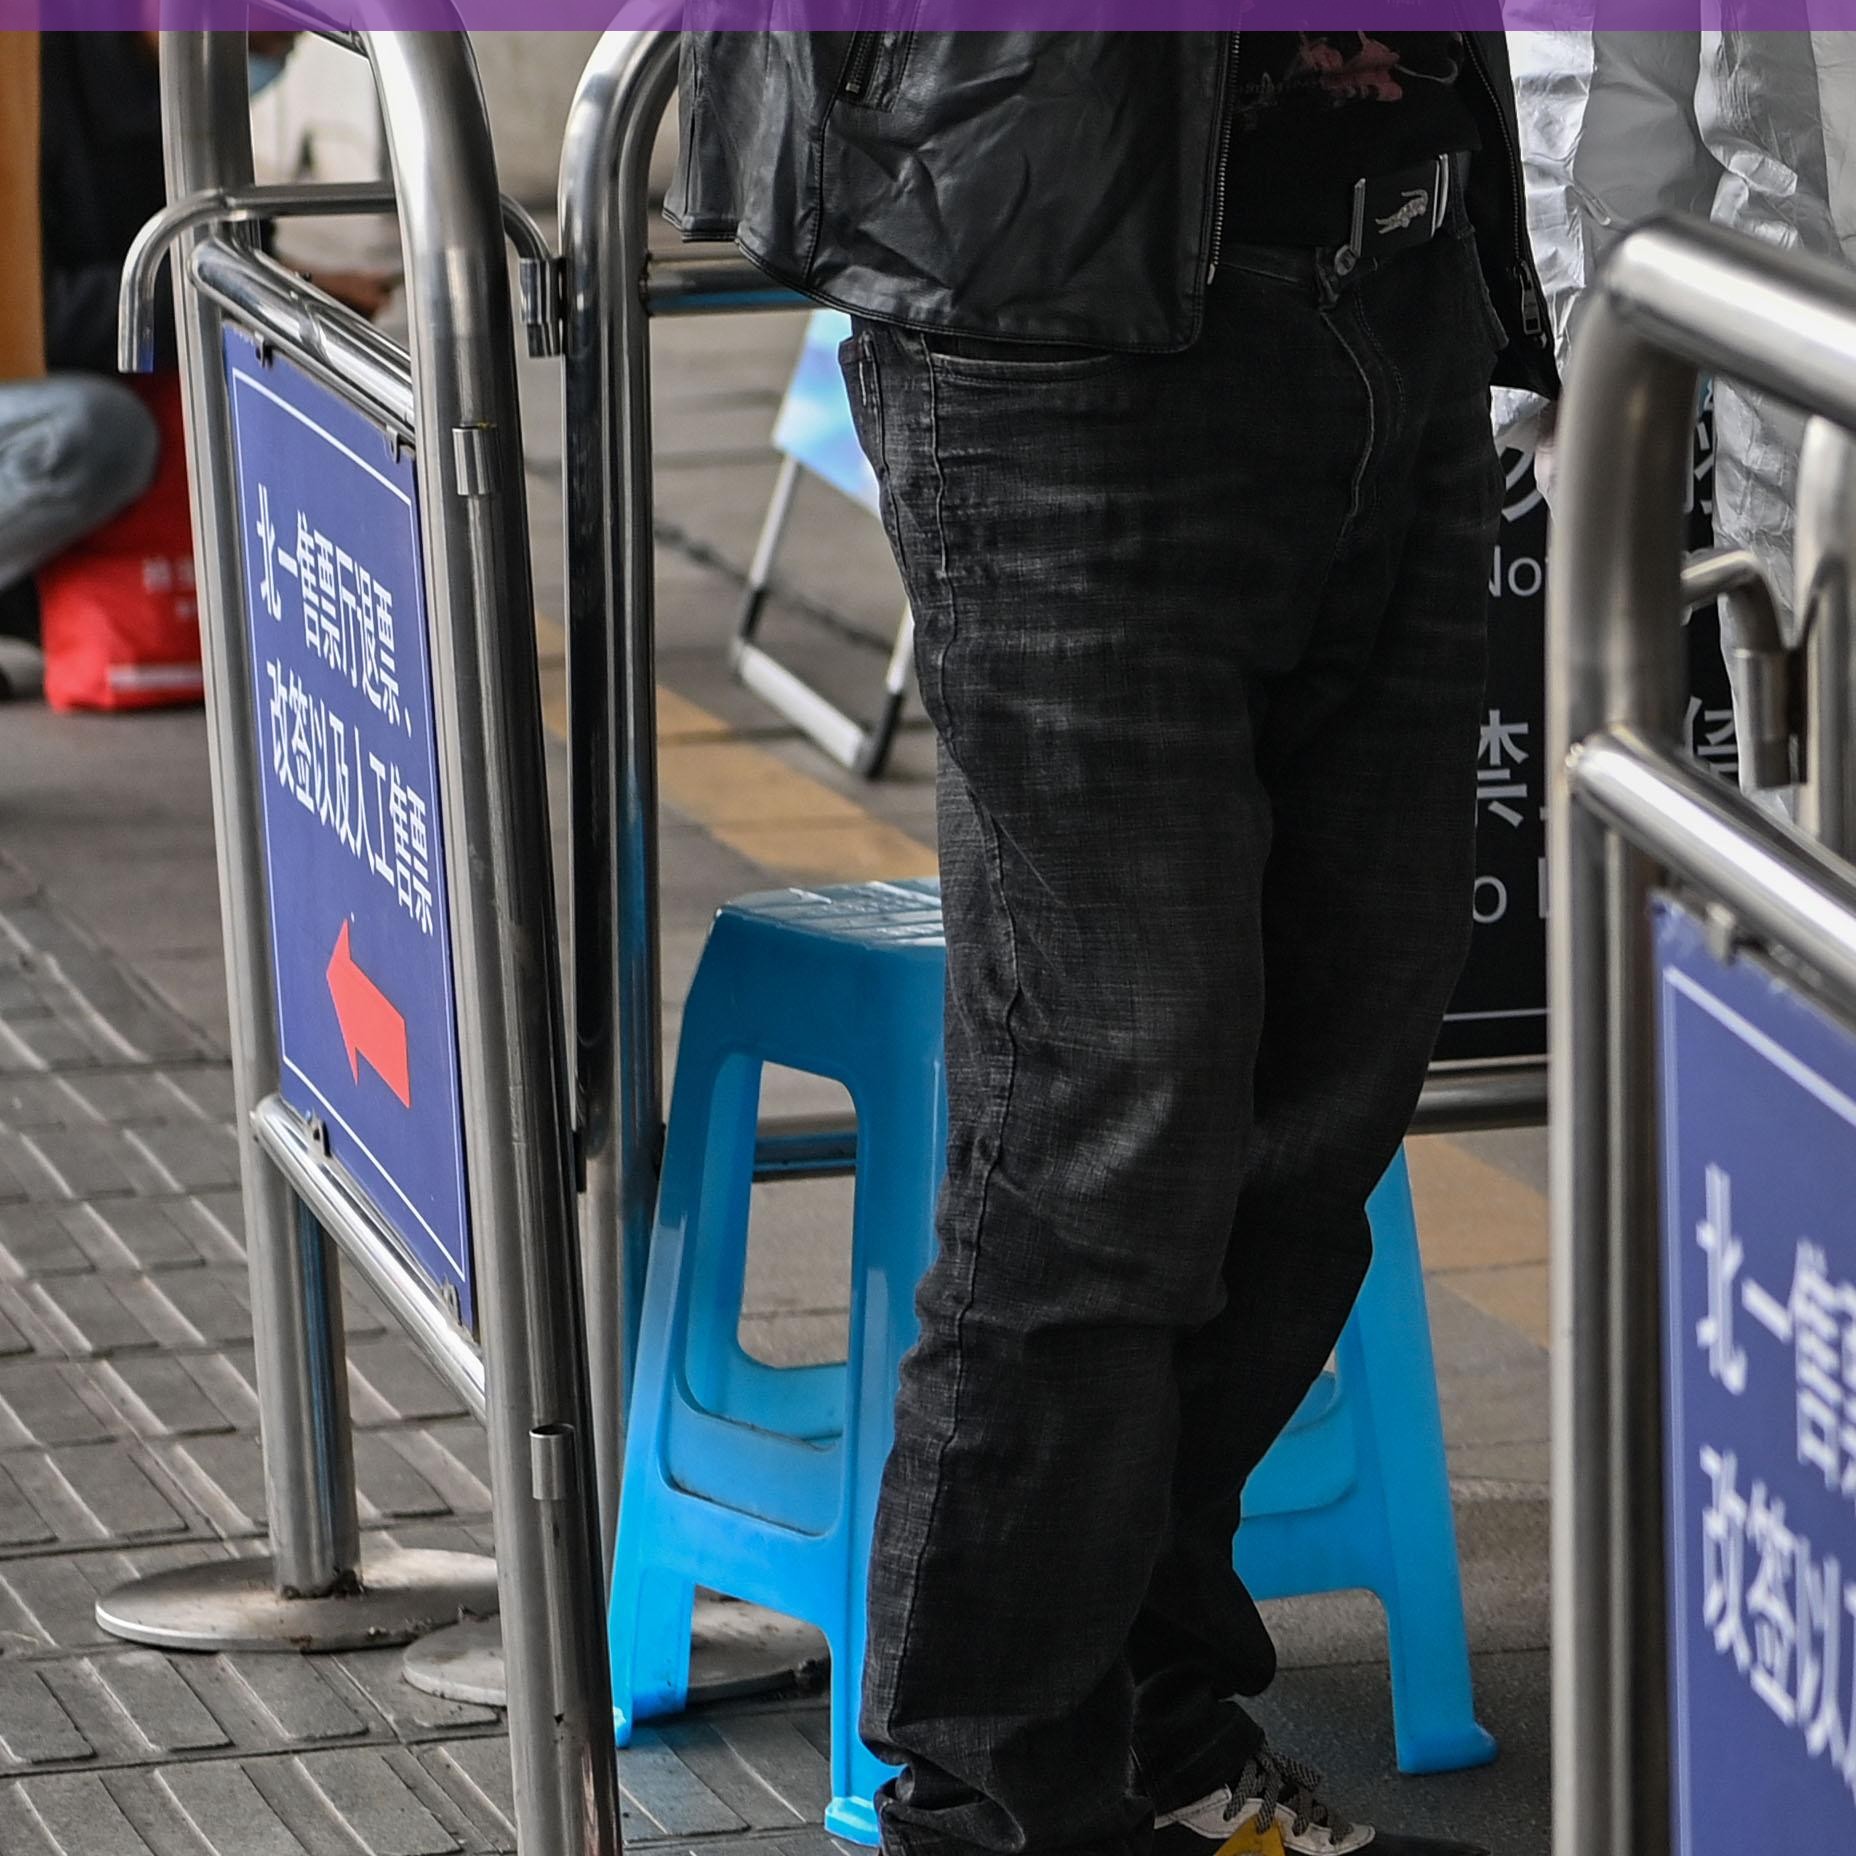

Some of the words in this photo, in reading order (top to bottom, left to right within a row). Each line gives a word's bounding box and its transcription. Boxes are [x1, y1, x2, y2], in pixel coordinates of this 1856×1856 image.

[266, 658, 434, 936] 改签以及人工售票
